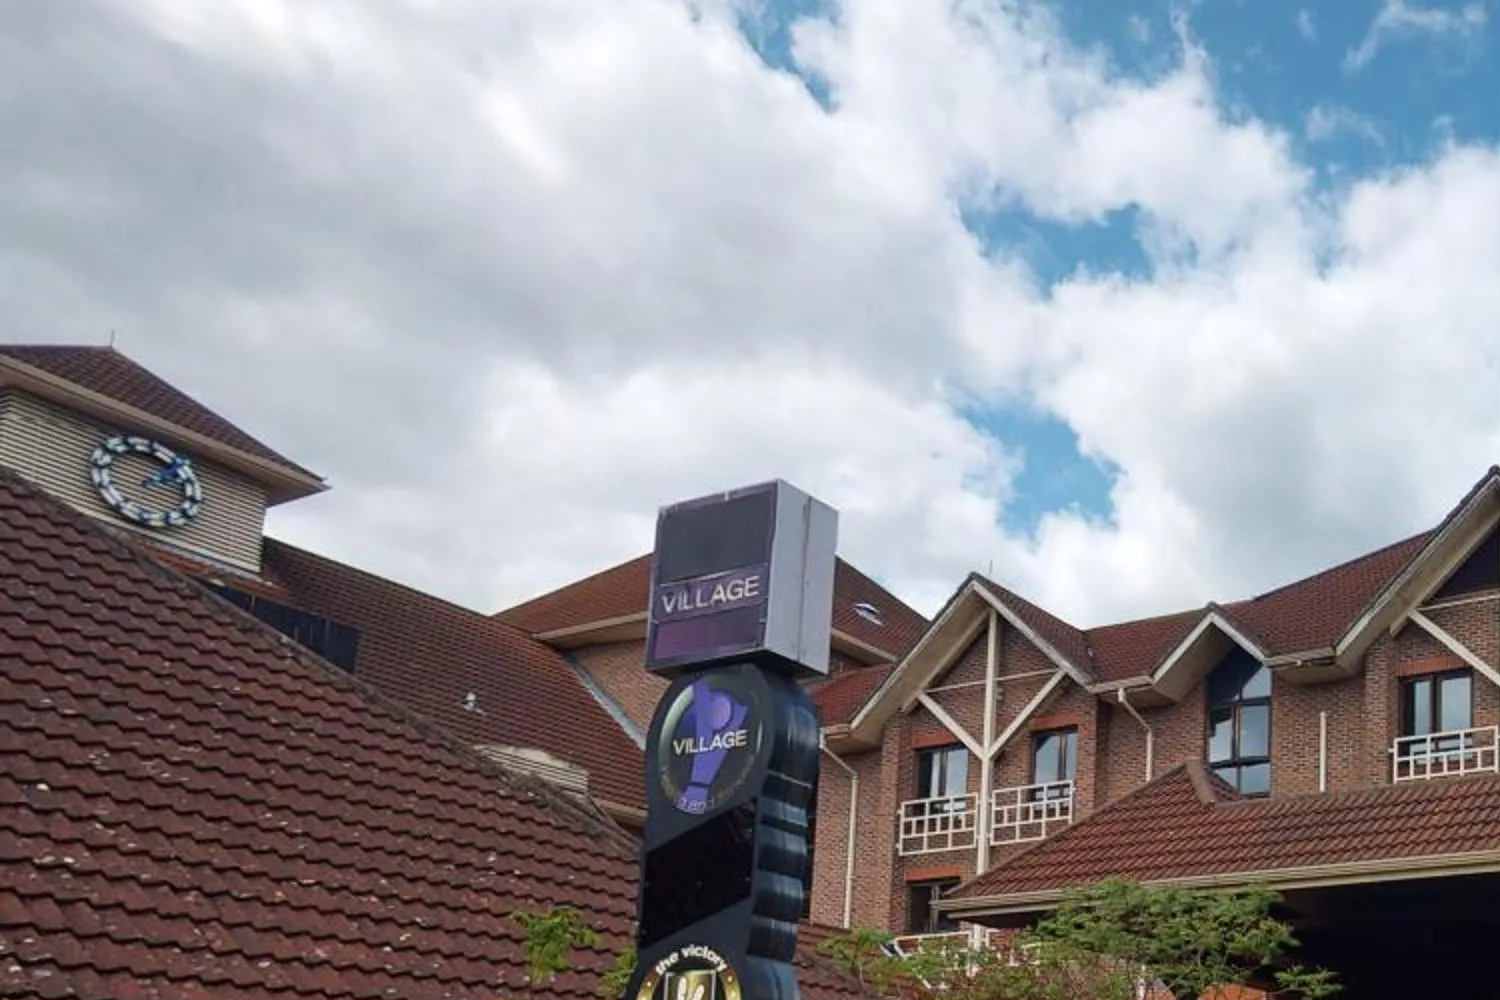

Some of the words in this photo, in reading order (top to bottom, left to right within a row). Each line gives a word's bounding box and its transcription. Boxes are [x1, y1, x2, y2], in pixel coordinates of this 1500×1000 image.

[661, 575, 760, 614] VILLAGE
[672, 728, 748, 756] VILLAGE
[655, 952, 679, 976] the
[682, 943, 728, 972] victory
